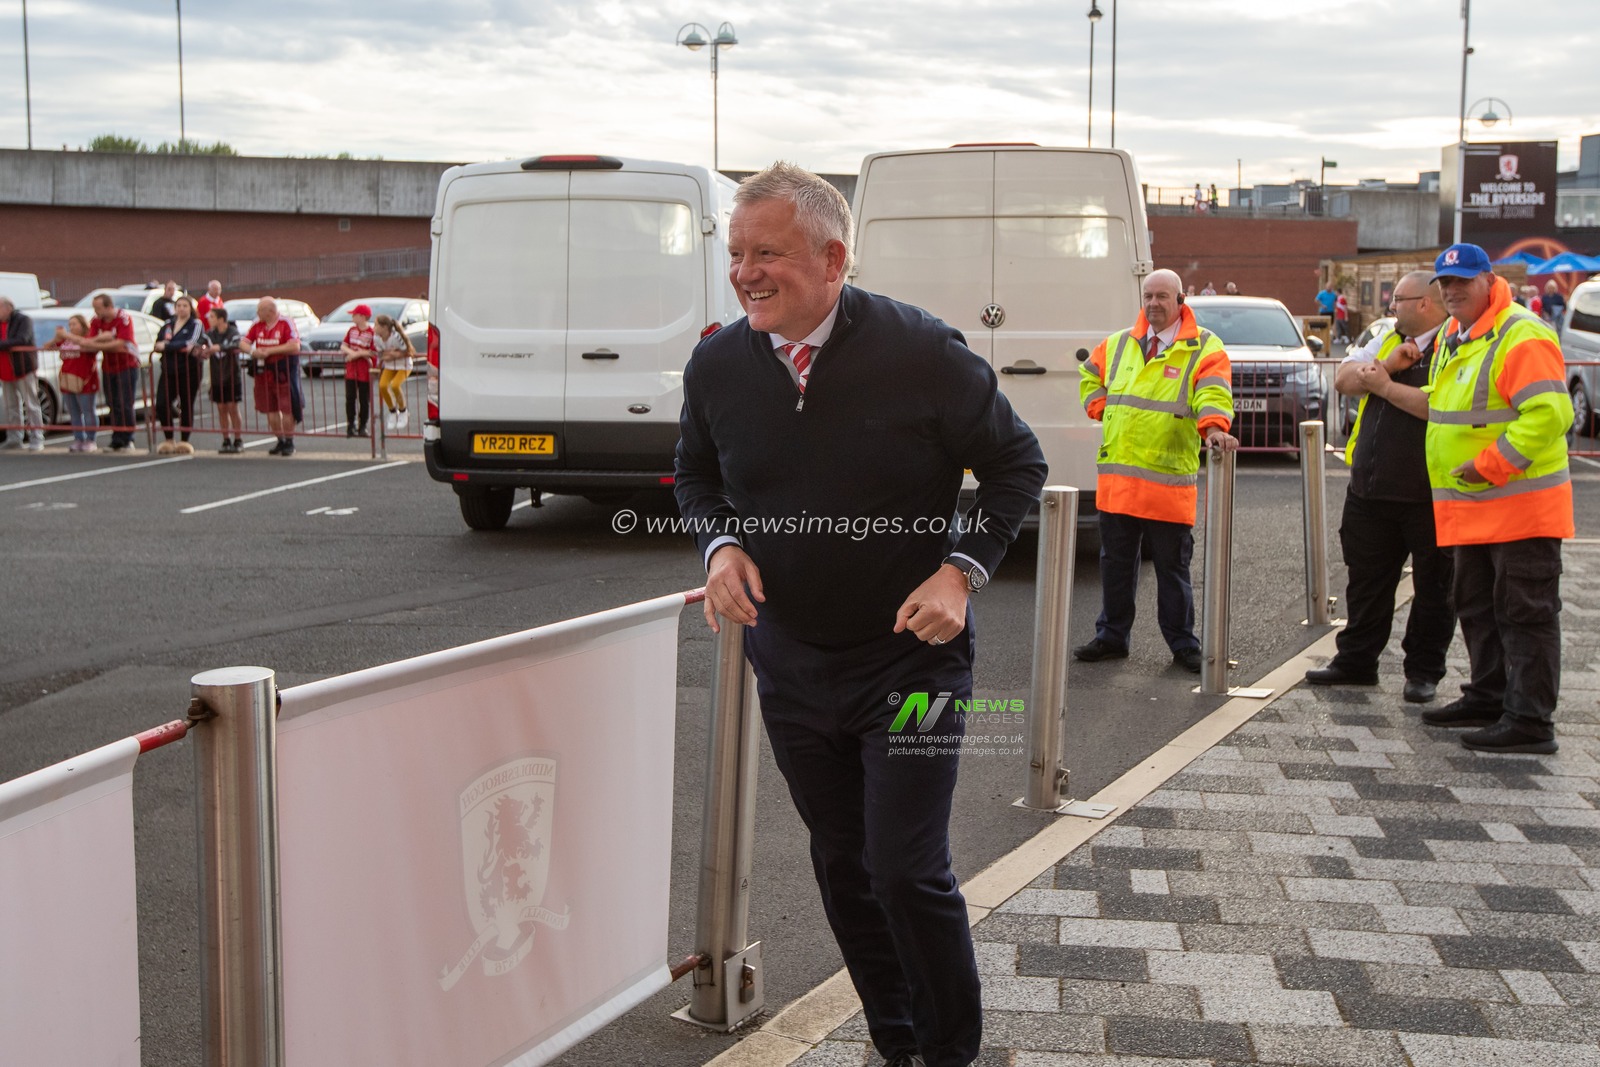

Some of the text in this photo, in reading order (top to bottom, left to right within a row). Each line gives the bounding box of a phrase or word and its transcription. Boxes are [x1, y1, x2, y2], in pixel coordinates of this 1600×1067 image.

[1480, 182, 1535, 193] WELCOME TO
[1470, 192, 1545, 206] THE RIVERSIDE
[1502, 205, 1535, 218] ZONE
[1243, 401, 1262, 409] DAN
[480, 436, 546, 451] YR20 RCZ
